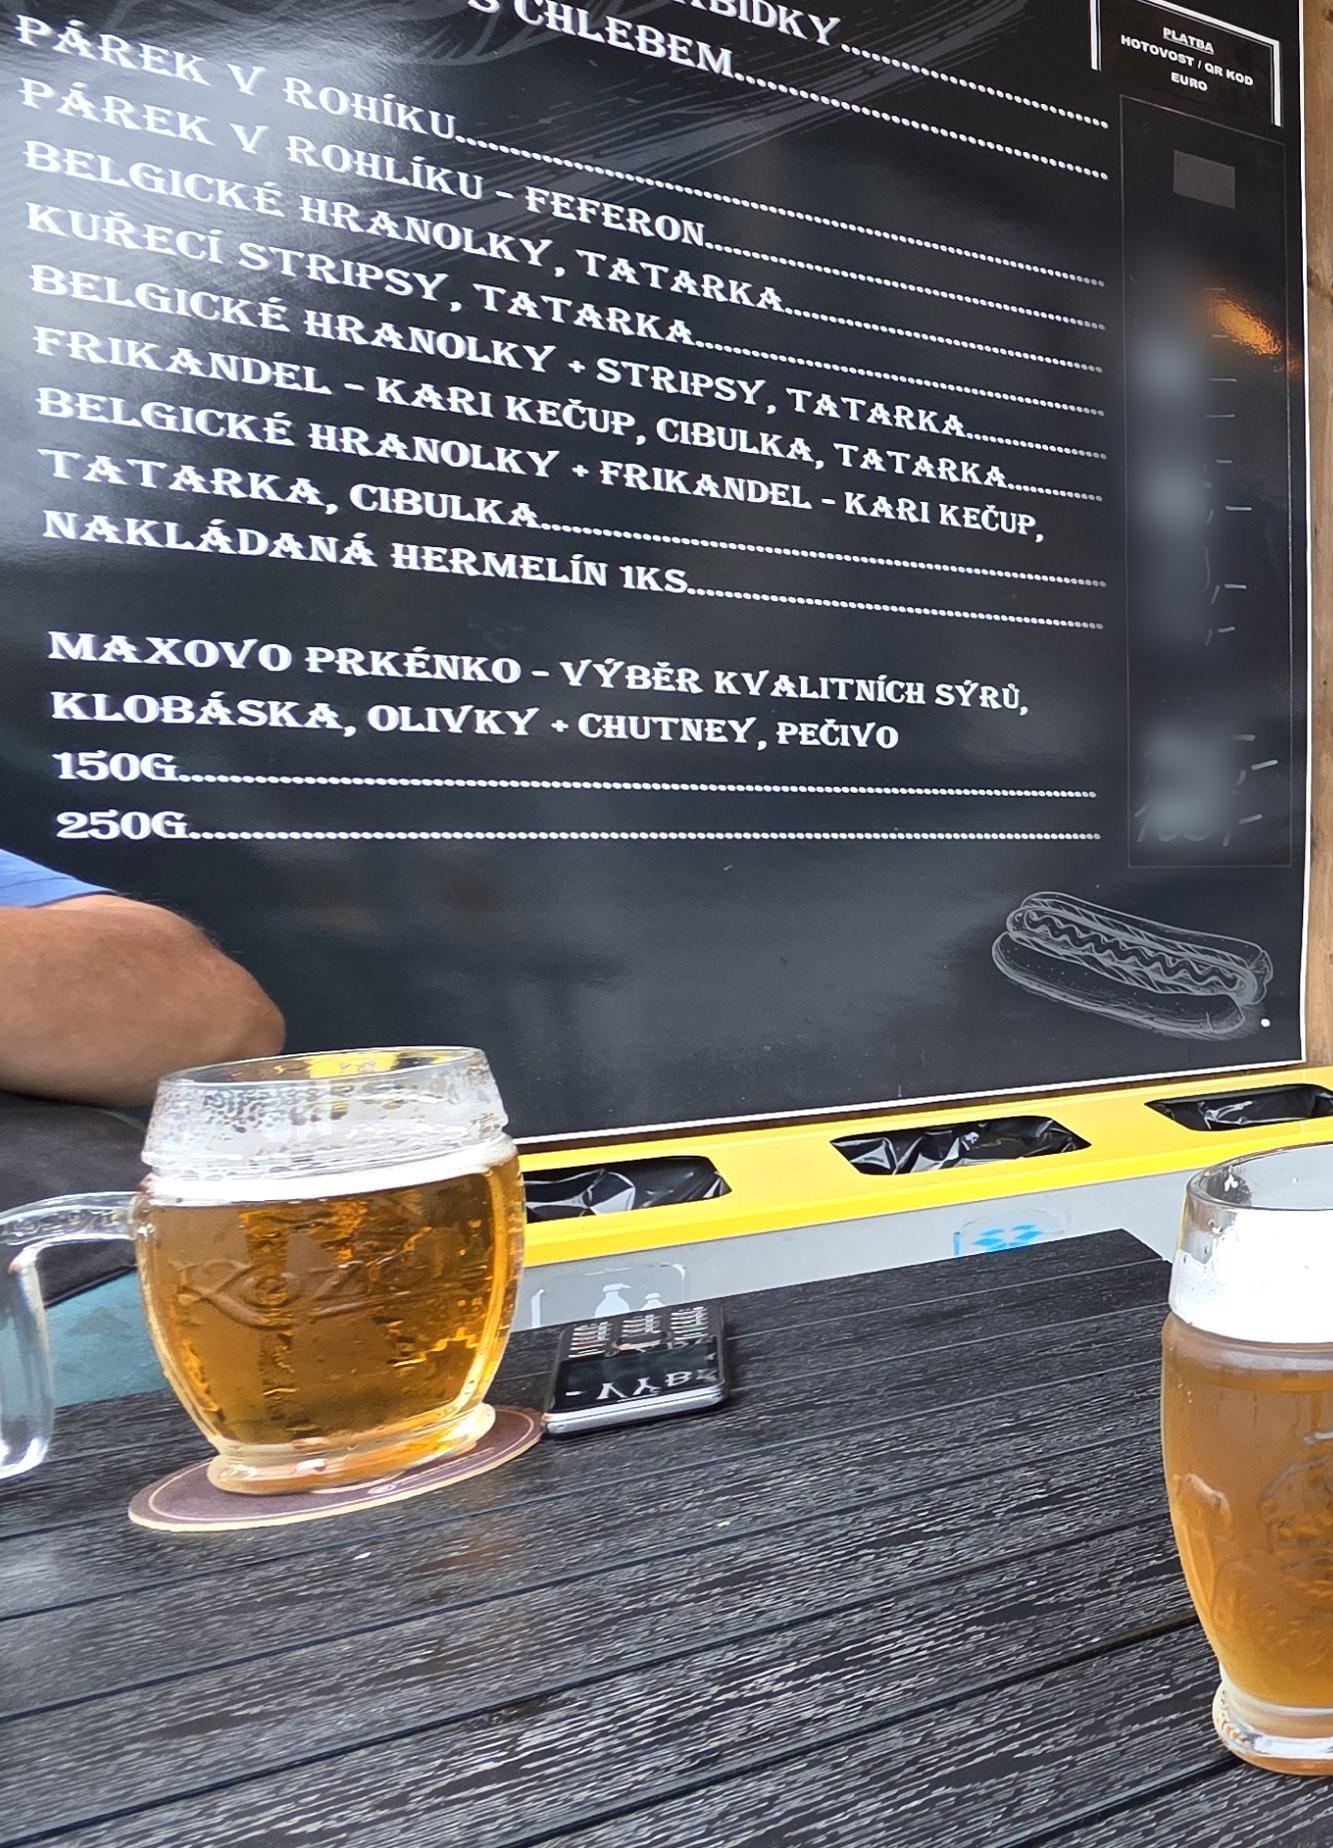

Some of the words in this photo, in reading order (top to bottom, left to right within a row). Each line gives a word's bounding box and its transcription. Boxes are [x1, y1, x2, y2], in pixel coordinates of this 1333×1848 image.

[15, 15, 210, 85] PÁREK
[227, 64, 265, 95] V
[283, 78, 455, 139] ROHÍKU
[514, 0, 734, 78] CHLEBEM
[1121, 34, 1195, 67] HOTOVOST
[1204, 62, 1223, 77] QR
[1226, 68, 1254, 86] KOD
[1163, 27, 1214, 53] PLATBA
[1171, 72, 1208, 91] EURO
[19, 78, 214, 145] PÁREK
[230, 124, 268, 154] V
[286, 136, 483, 199] ROHLÍKU
[525, 186, 704, 246] FEFERON
[23, 141, 285, 217] BELGICKÉ
[299, 195, 565, 277] HRANOLKY,
[576, 250, 784, 312] TATARKA
[26, 203, 224, 264] KUŘECÍ
[238, 242, 461, 312] STRIPSY,
[473, 284, 695, 345] TATARKA
[29, 265, 290, 332] BELGICKÉ
[303, 310, 556, 372] HRANOLKY
[597, 358, 776, 414] STRIPSY,
[786, 388, 966, 437] TATARKA
[33, 326, 332, 394] FRIKANDEL
[376, 377, 493, 417] KARI
[505, 396, 645, 445] KEČUP,
[657, 418, 824, 469] CIBULKA,
[833, 443, 1007, 488] TATARKA
[35, 388, 295, 446] BELGICKÉ
[308, 423, 559, 477] HRANOLKY
[600, 461, 812, 509] FRIKANDEL
[845, 492, 930, 523] KARI
[939, 504, 1043, 542] KEČUP,
[37, 449, 338, 514] TATARKA,
[350, 484, 541, 530] CIBULKA
[43, 510, 378, 567] NAKLÁDANÁ
[391, 543, 608, 586] HERMELÍN
[619, 566, 688, 593] 1KS
[48, 631, 292, 671] MAXOVO
[305, 646, 521, 683] PRKÉNKO
[560, 658, 703, 693] VÝBĚR
[715, 670, 926, 704] KVALITNÍCH
[935, 680, 1028, 715] SÝRŮ,
[51, 691, 356, 737] KLOBÁSKA,
[368, 705, 539, 735] OLIVKY
[578, 713, 767, 750] CHUTNEY,
[776, 719, 898, 748] PEČIVO
[52, 752, 178, 782] 150G
[56, 811, 188, 840] 250G
